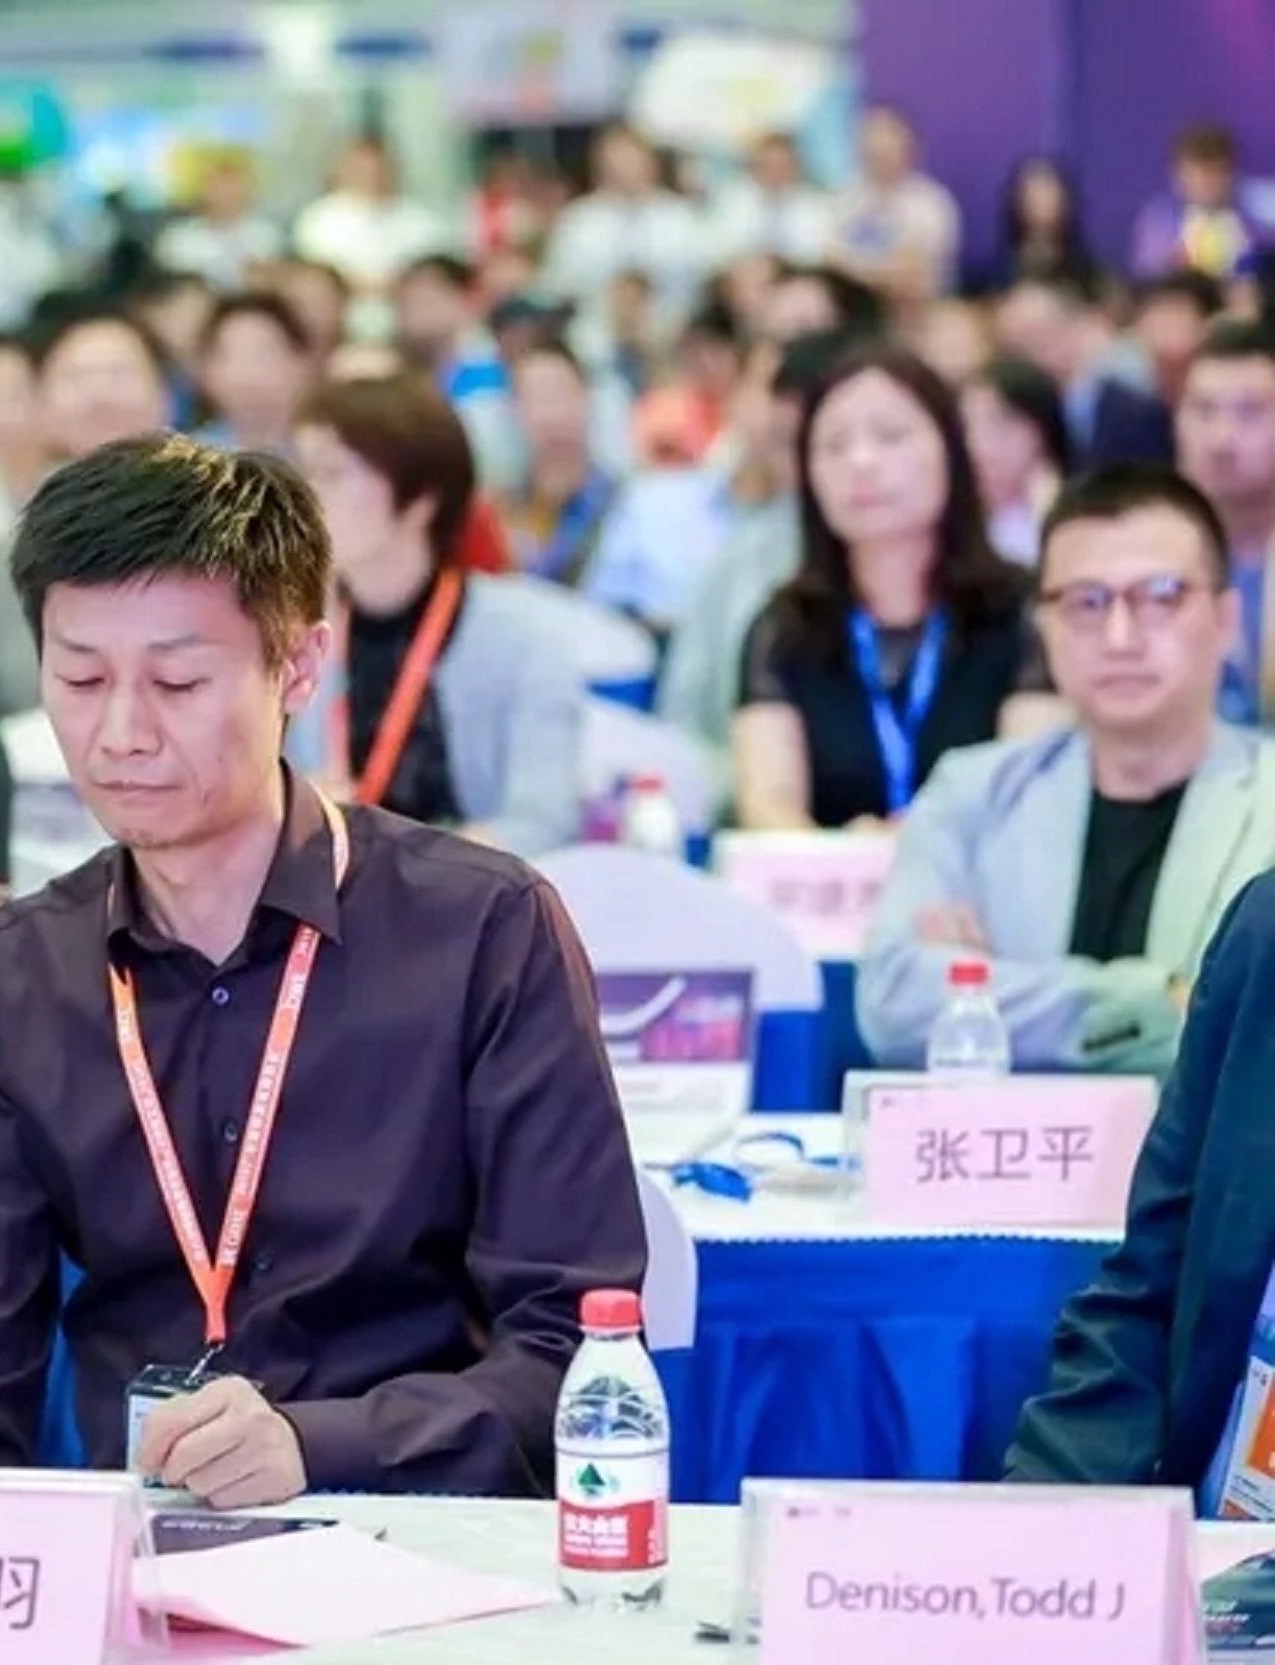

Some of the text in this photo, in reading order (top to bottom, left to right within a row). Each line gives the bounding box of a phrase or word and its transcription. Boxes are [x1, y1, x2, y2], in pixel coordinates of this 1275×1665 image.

[915, 1125, 1095, 1184] 张卫平
[1107, 1581, 1126, 1622] J
